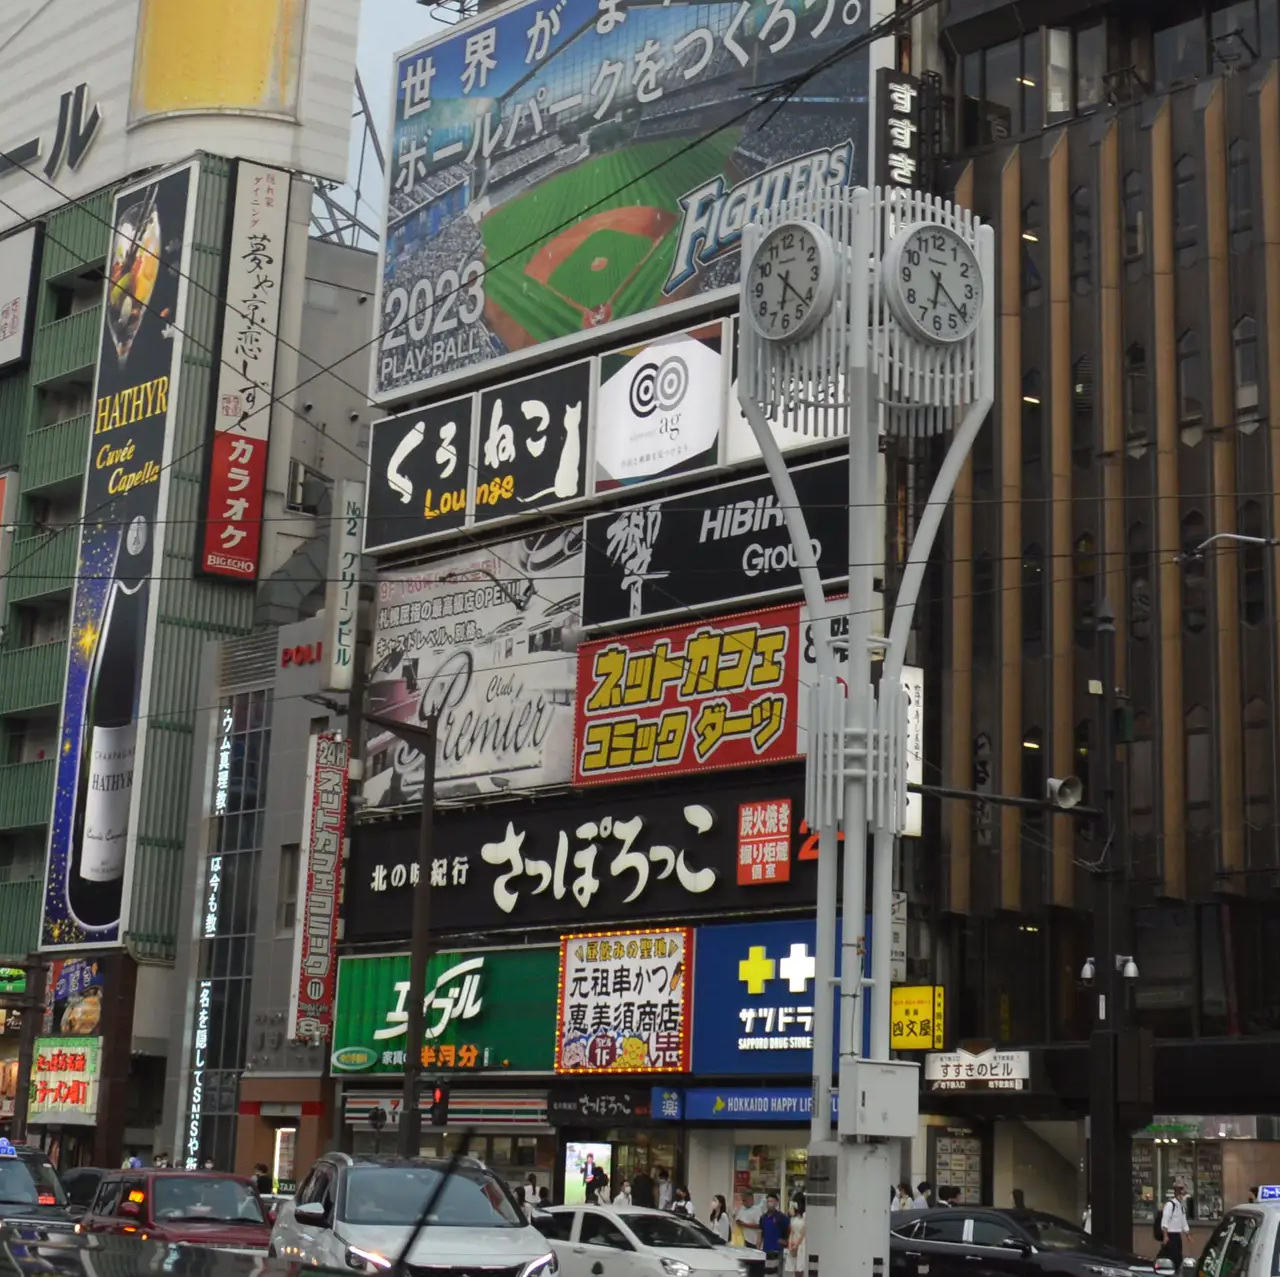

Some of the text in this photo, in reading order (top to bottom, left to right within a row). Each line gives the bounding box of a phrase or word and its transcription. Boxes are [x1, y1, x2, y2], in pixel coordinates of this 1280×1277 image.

[662, 138, 855, 298] FIGHTERS
[781, 233, 795, 250] 12
[798, 236, 805, 252] 1
[917, 237, 929, 252] 11
[930, 236, 946, 251] 12
[769, 246, 779, 261] 11
[807, 246, 816, 262] 2
[905, 249, 920, 266] 10
[950, 247, 958, 262] 1
[758, 263, 771, 278] 10
[810, 265, 819, 282] 3
[902, 267, 912, 282] 9
[960, 262, 970, 279] 2
[755, 282, 764, 298] 9
[907, 288, 917, 304] 8
[964, 284, 974, 300] 3
[380, 259, 486, 352] 2023
[758, 301, 768, 316] 8
[795, 304, 804, 320] 5
[918, 305, 929, 322] 7
[770, 312, 778, 327] 7
[781, 313, 791, 329] 6
[932, 315, 942, 331] 6
[947, 313, 958, 329] 5
[381, 335, 481, 381] PLAY BALL
[94, 374, 170, 435] HATHYR
[95, 437, 136, 471] Cuvée
[387, 398, 551, 504] くろねこ
[107, 460, 161, 498] Capella
[219, 438, 255, 550] カラオケ
[424, 474, 515, 520] Lounge
[698, 494, 789, 544] HIBIK
[207, 553, 255, 574] BIG ECHO
[334, 551, 359, 667] グリーンビル
[586, 623, 788, 713] ネットカフェ
[581, 692, 787, 772] コミック ダーツ
[318, 738, 347, 769] 24H
[740, 803, 789, 836] 炭火焼き
[480, 803, 718, 914] さっぽろっこ
[585, 938, 668, 963] 昼飲みの聖地
[570, 964, 669, 999] 元祖串かつ
[567, 999, 681, 1035] 恵美須商店
[739, 1006, 815, 1033] サツドラ
[738, 1036, 814, 1050] SAPPORO DRUG STORE
[420, 1044, 480, 1068] 半月分
[595, 1049, 610, 1066] 1F
[940, 1062, 1014, 1078] すすきのビル
[727, 1097, 797, 1113] HOKKAIDO HAPPY
[279, 1182, 296, 1192] TAXI
